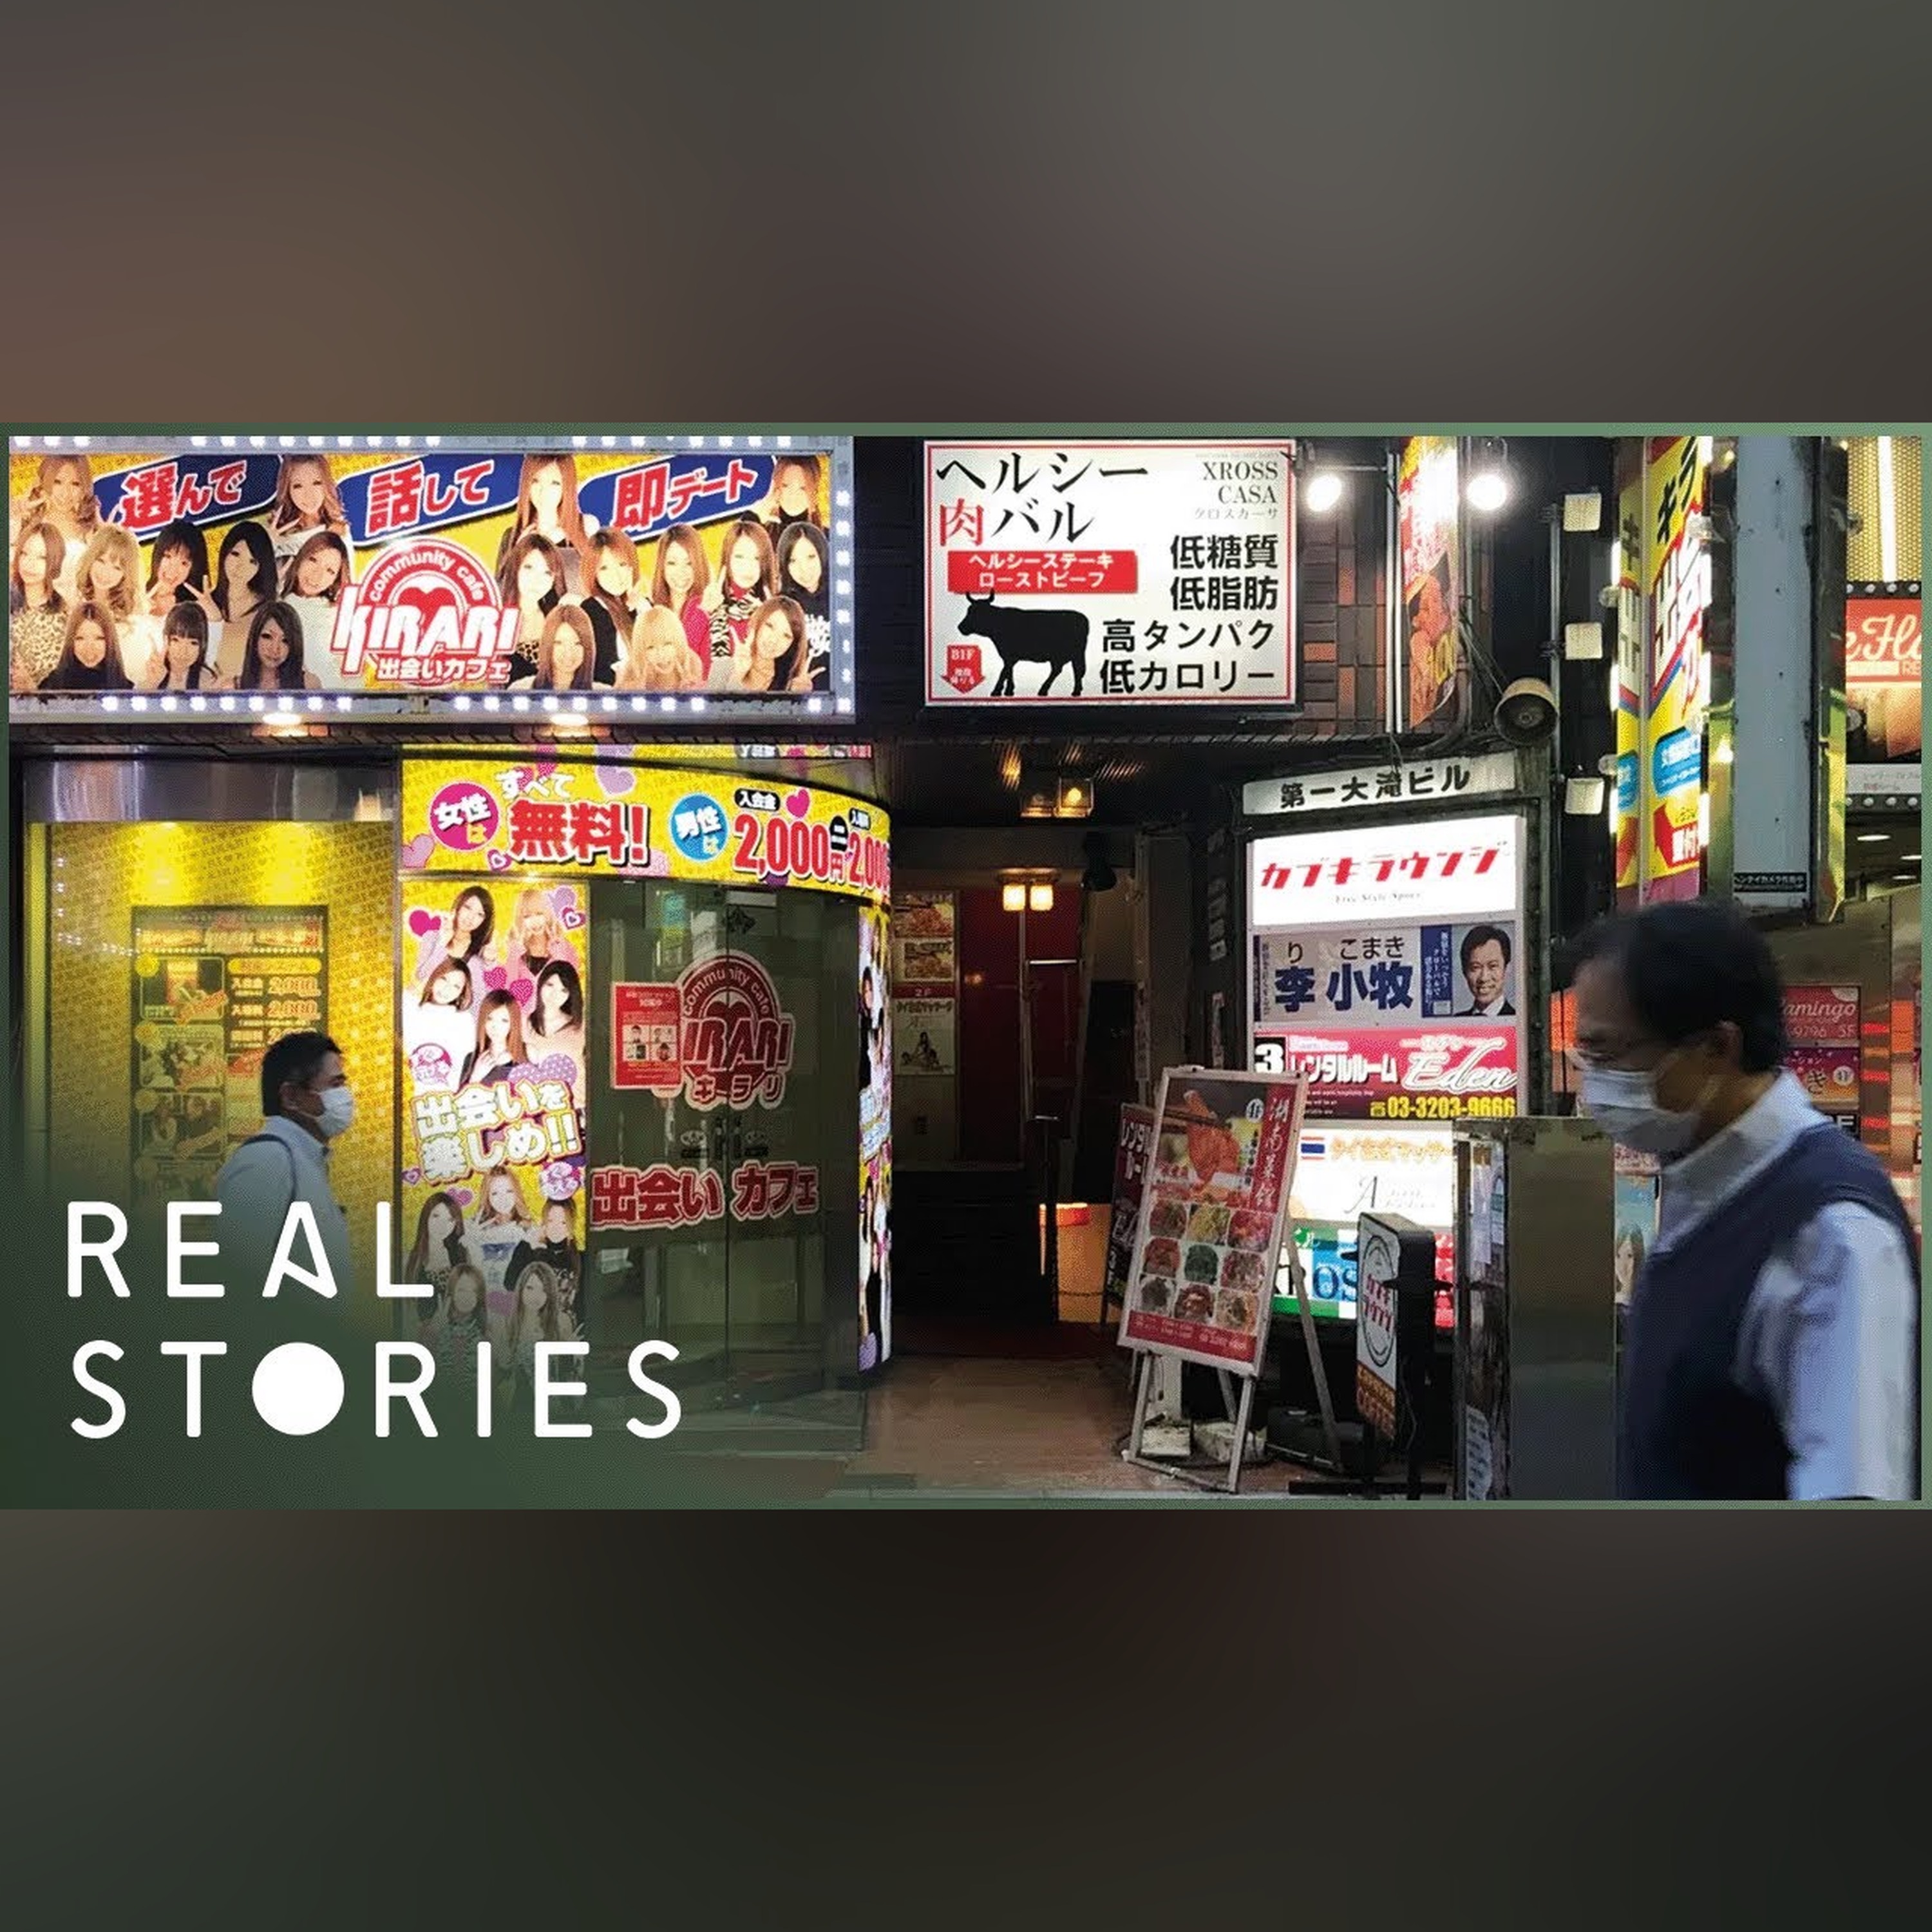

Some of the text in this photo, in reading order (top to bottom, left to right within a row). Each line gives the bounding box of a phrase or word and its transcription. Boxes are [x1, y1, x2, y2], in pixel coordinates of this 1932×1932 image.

[936, 452, 1148, 494] ヘルシー
[1202, 460, 1278, 480] XROSS
[122, 459, 247, 531] 選んで
[366, 459, 494, 537] 話して
[612, 459, 758, 531] 即デート
[1218, 485, 1278, 504] CASA
[940, 497, 1095, 547] 肉バル
[969, 553, 1113, 569] ヘルシーステーキ
[1170, 535, 1278, 570] 低糖質
[370, 549, 484, 601] community cafe
[979, 571, 1105, 589] ローストビーフ
[1170, 576, 1278, 611] 低脂肪
[330, 585, 520, 675] KIRARI
[1102, 619, 1275, 653] 高タンパク
[378, 658, 511, 682] 出会いカフェ
[1099, 659, 1275, 695] 低カロリー
[496, 770, 575, 798] すべて
[1280, 765, 1471, 810] 第一大滝ビル
[433, 795, 492, 830] 女性
[675, 805, 722, 839] 男性
[508, 799, 650, 865] 無料!
[1260, 840, 1509, 889] カブキラウンジ
[1288, 936, 1405, 964] り こまき
[1274, 965, 1316, 1012] 李
[1325, 961, 1414, 1010] 小牧
[1783, 1000, 1857, 1023] amingo
[682, 1018, 792, 1073] IRARI
[1255, 1043, 1286, 1074] 3
[1403, 1038, 1517, 1094] Eden
[414, 1082, 570, 1139] 出会いを
[1387, 1096, 1515, 1119] 03-3203-9666
[592, 1168, 724, 1226] 出会い
[734, 1164, 820, 1217] カフェ
